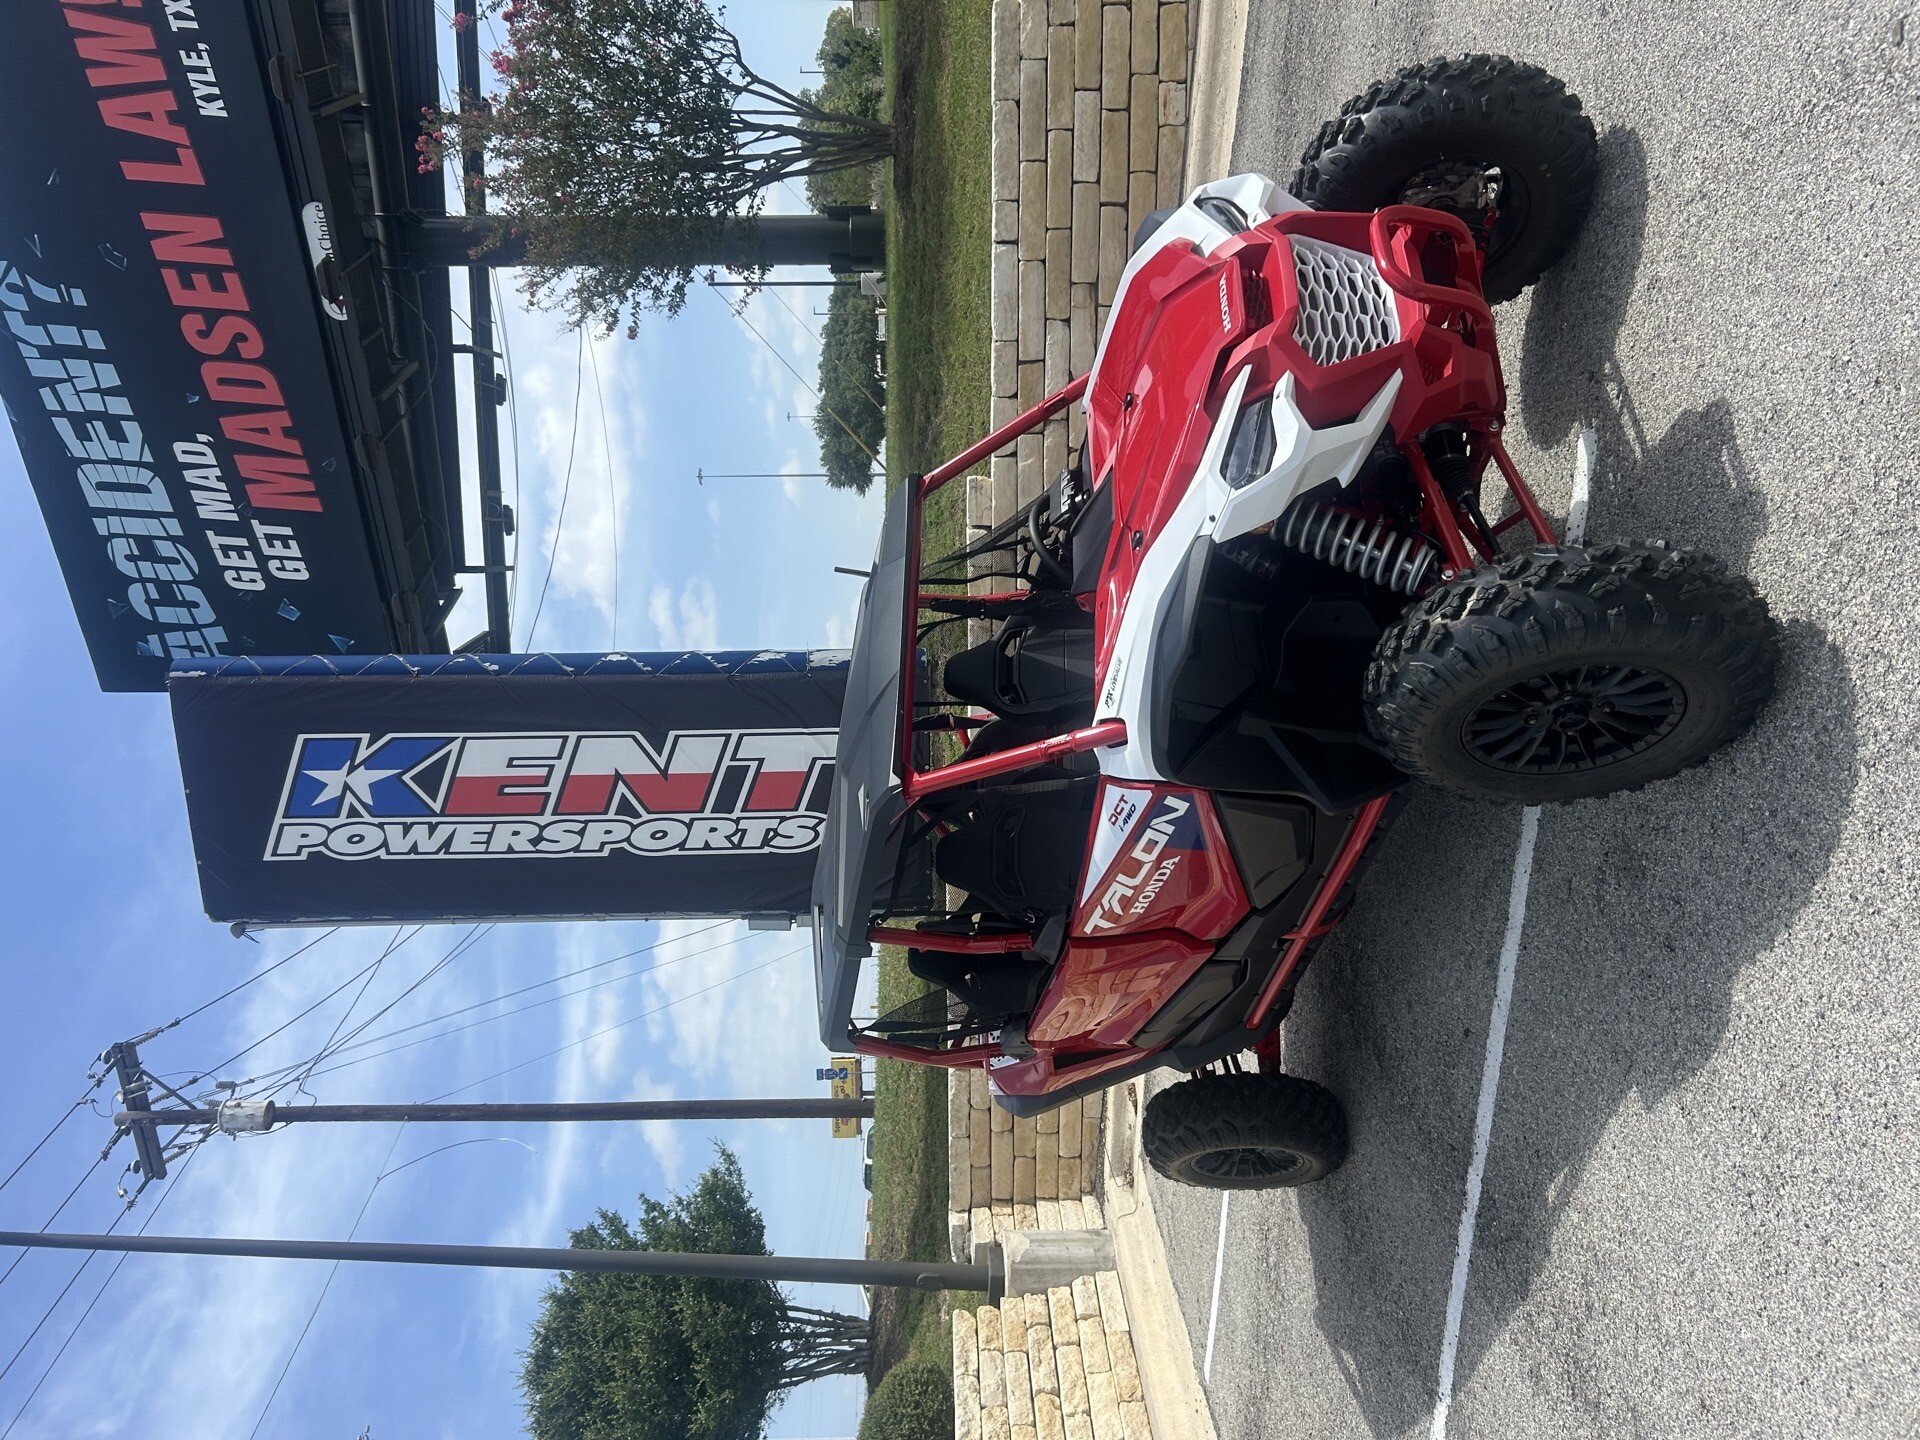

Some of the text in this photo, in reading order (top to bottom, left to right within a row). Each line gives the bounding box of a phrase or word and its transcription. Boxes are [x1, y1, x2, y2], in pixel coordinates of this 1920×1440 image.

[179, 42, 229, 117] KYLE,
[60, 0, 323, 581] GET MADSEN LAW
[1219, 272, 1232, 334] HONDA
[0, 261, 237, 657] ACCIDENT?
[172, 433, 266, 591] GET MAD,
[283, 733, 839, 815] KENT
[1108, 794, 1128, 826] DCT
[270, 817, 824, 858] POWERSPORTS
[1084, 796, 1190, 934] TALON
[1129, 856, 1181, 914] HONDA
